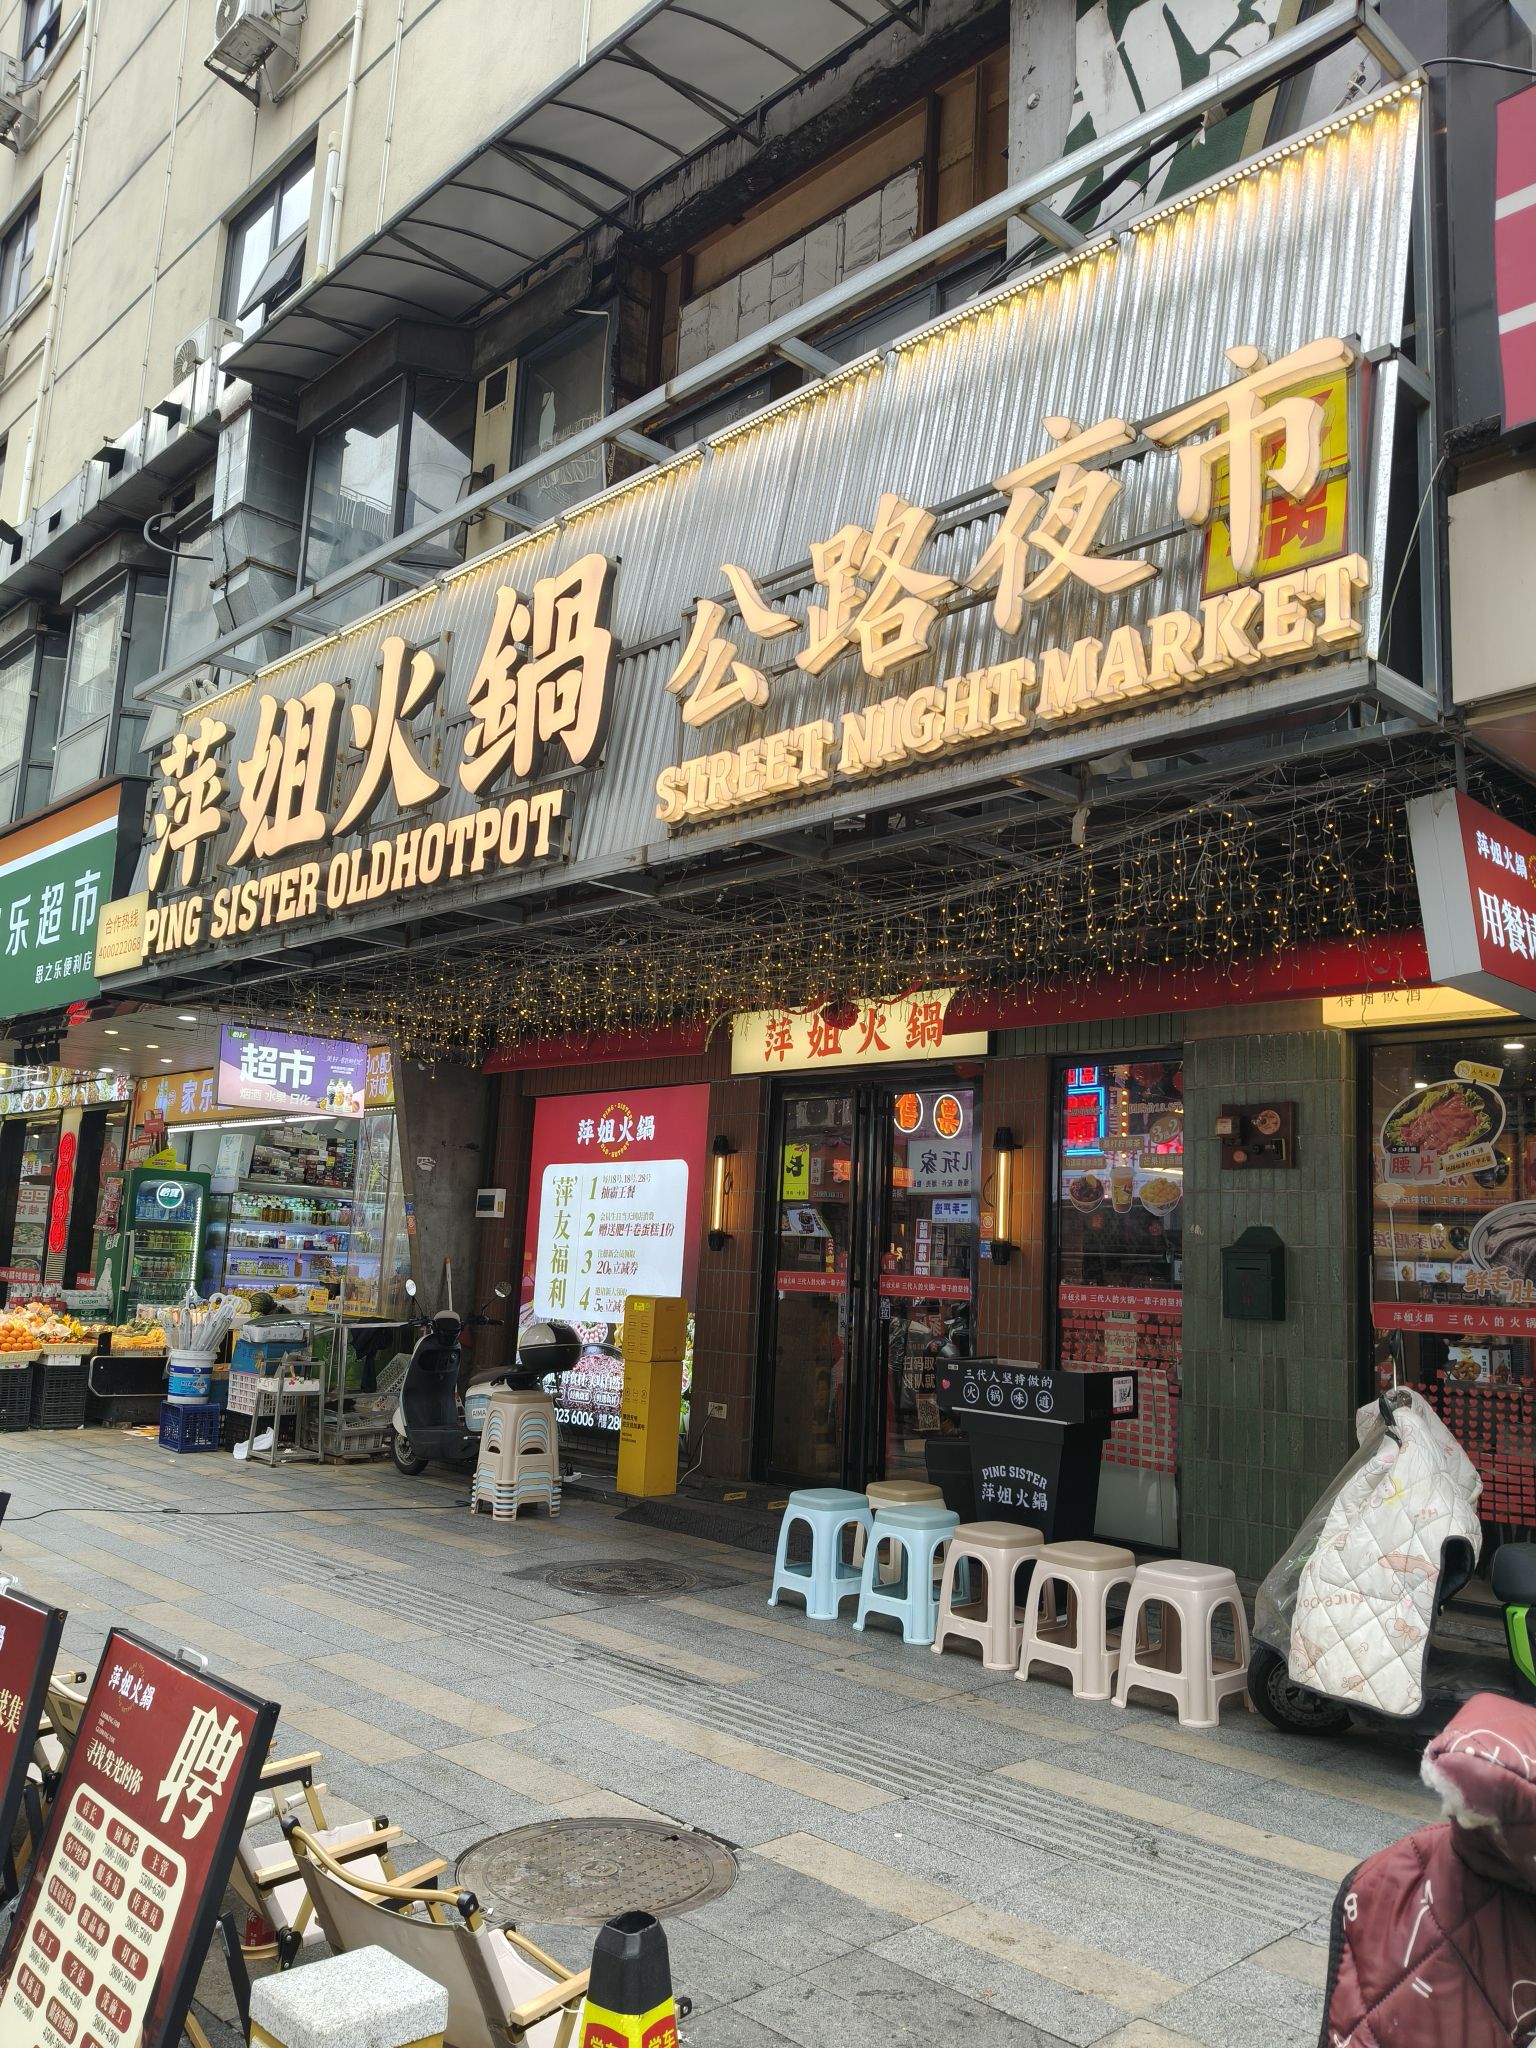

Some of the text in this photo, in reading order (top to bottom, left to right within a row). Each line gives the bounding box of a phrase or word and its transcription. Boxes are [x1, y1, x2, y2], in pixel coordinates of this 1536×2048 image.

[667, 336, 1360, 728] 公路夜市
[655, 552, 1369, 824] STREET NIGHT MARKET
[148, 553, 615, 891] 萍姐火鍋
[142, 789, 564, 956] PING SISTER OLDHOTPOT
[0, 870, 100, 955] 乐超市
[105, 909, 138, 935] 合作热线
[35, 951, 92, 983] 思之乐便利店
[765, 1001, 943, 1062] 萍姐火鍋
[240, 1043, 315, 1088] 超市
[240, 1088, 261, 1100] 烟酒
[265, 1090, 286, 1102] 水果
[366, 1076, 388, 1098] 对味
[577, 1115, 655, 1145] 萍姐火鍋
[1391, 1155, 1434, 1175] 腰片
[589, 1176, 598, 1200] 1
[584, 1213, 595, 1236] 2
[581, 1250, 593, 1274] 3
[579, 1287, 590, 1310] 4
[903, 1357, 936, 1371] 扫码取
[964, 1369, 1053, 1389] 三代人坚持做的
[571, 1411, 594, 1427] 6006
[607, 1415, 622, 1430] 28
[982, 1465, 1048, 1490] PING SISTER
[981, 1483, 1048, 1511] 萍姐火鍋
[87, 1738, 143, 1795] 寻找发光的你
[157, 1705, 243, 1840] 聘
[149, 1854, 170, 1878] 主管
